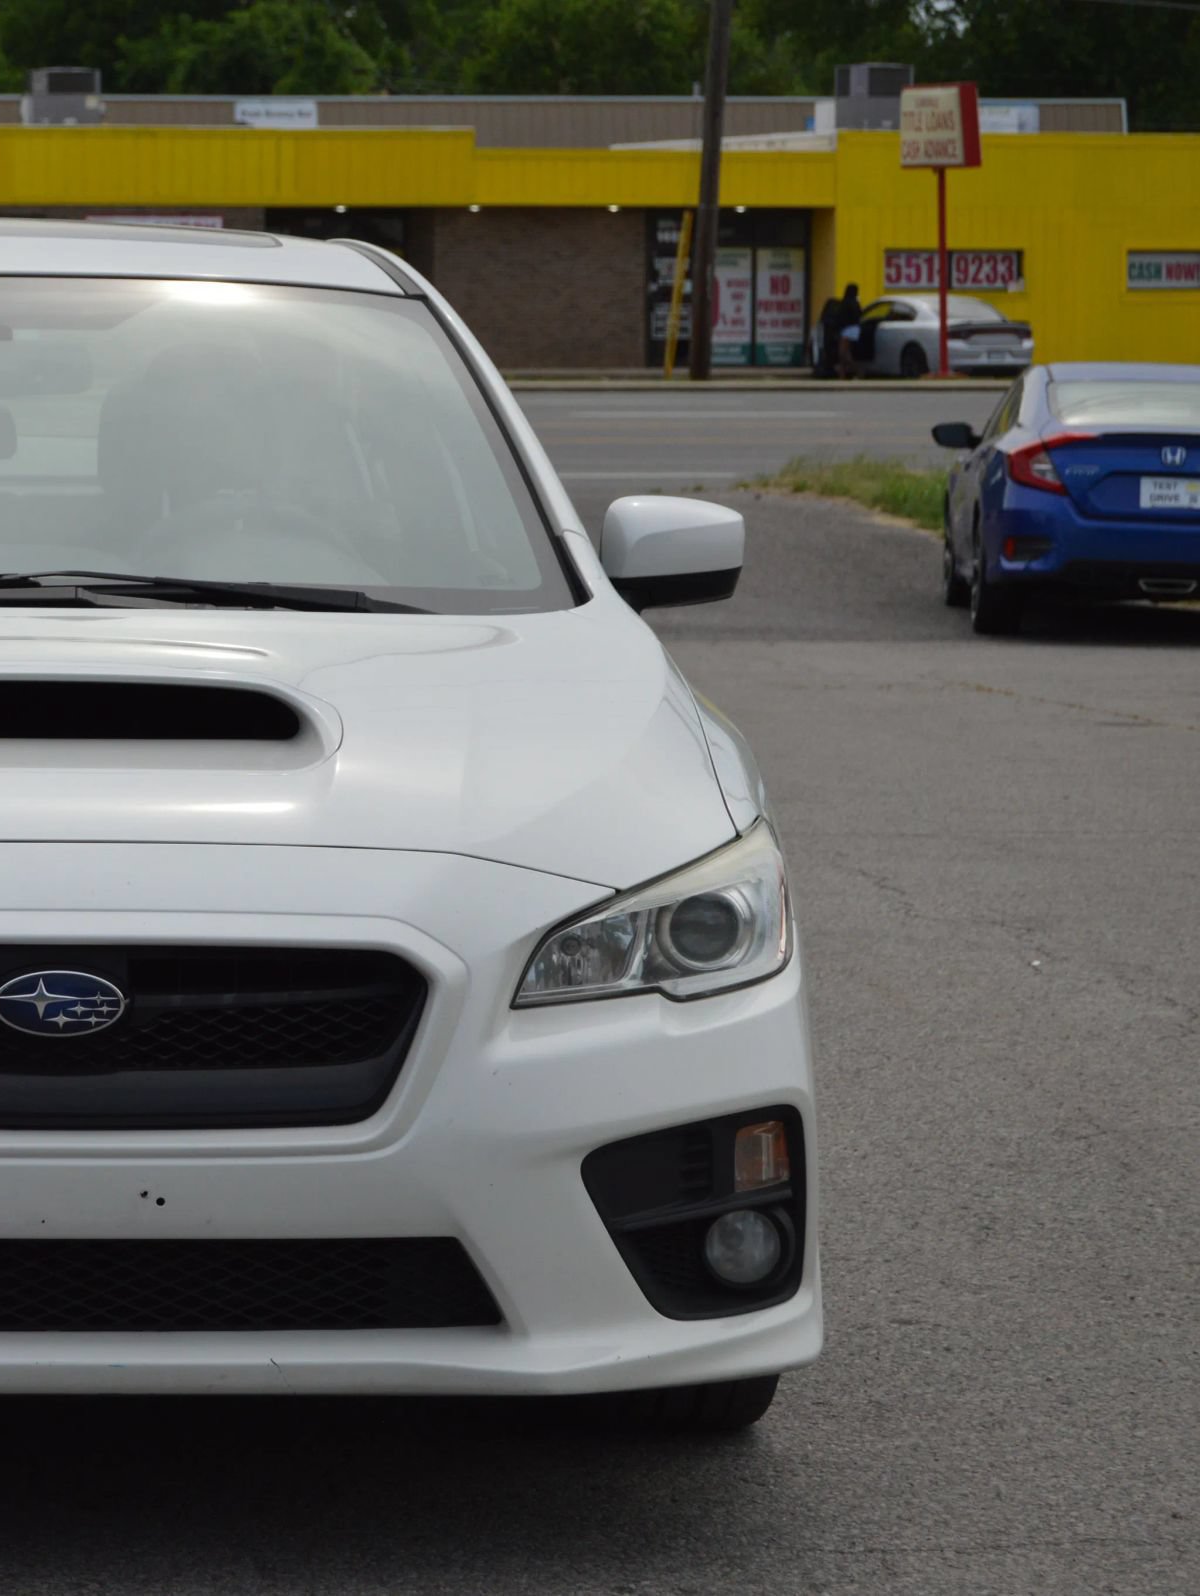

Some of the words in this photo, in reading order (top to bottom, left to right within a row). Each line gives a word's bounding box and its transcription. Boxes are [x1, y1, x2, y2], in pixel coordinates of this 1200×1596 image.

[926, 110, 955, 132] LOANS
[923, 138, 958, 159] ADVANCE
[955, 254, 1015, 284] 9233
[1128, 262, 1162, 281] CASH
[769, 274, 791, 296] NO
[1152, 480, 1179, 491] TEST
[1149, 493, 1181, 504] DRIVE
